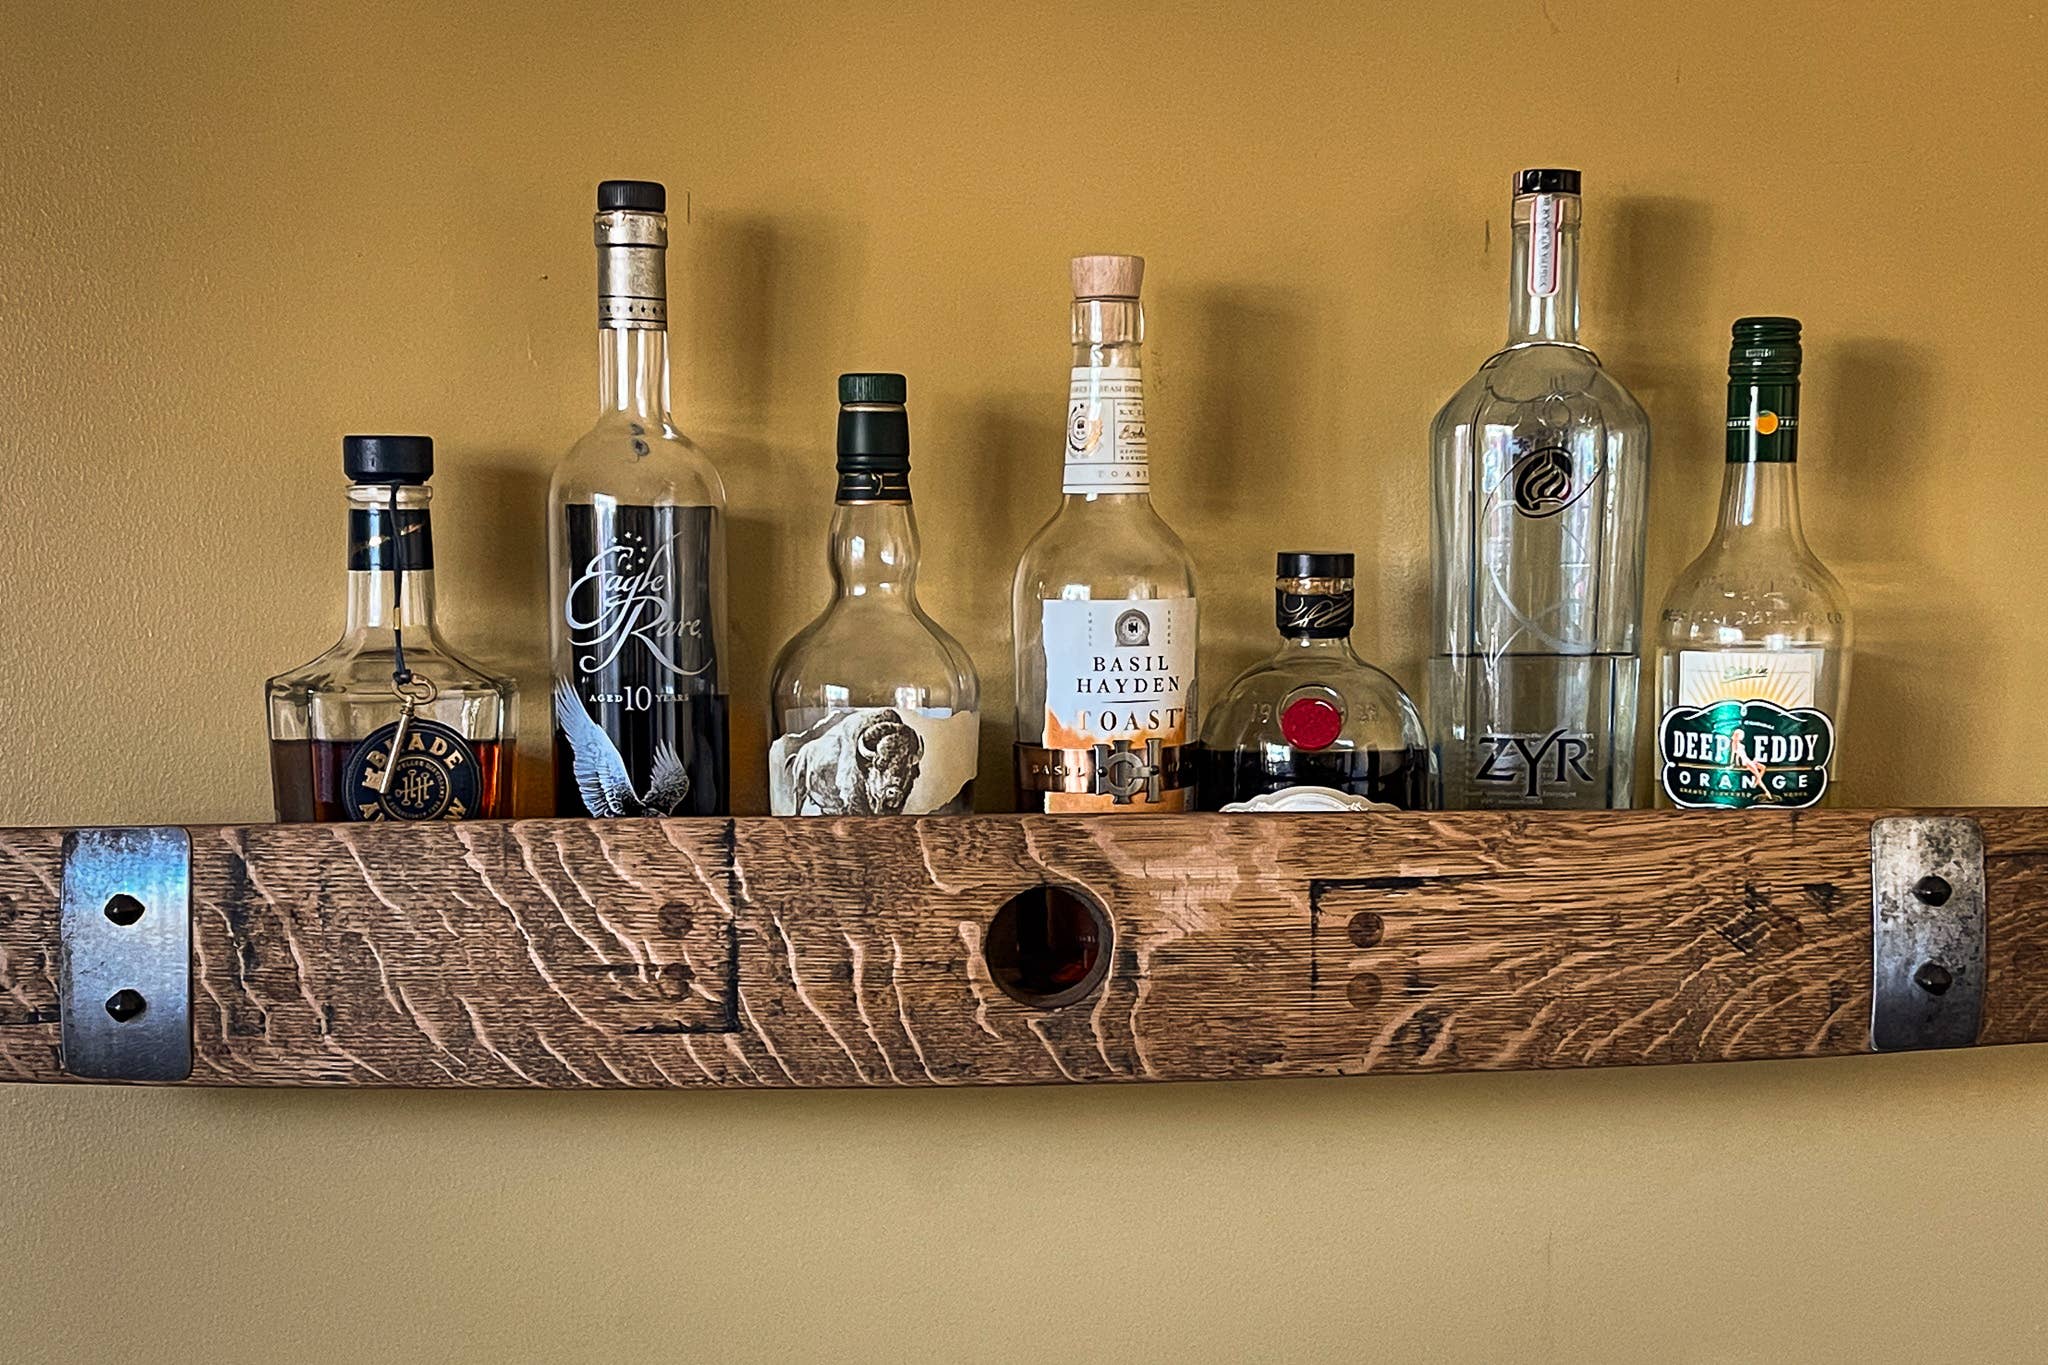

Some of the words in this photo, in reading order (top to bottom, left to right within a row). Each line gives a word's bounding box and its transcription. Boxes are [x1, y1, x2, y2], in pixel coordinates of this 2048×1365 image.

[565, 531, 682, 646] Eagle
[579, 596, 713, 676] Rare
[1094, 655, 1169, 672] BASIL
[1077, 676, 1180, 694] HAYDEN
[590, 693, 623, 703] AGED
[624, 685, 652, 711] 10
[655, 693, 689, 702] YEARS
[1075, 707, 1177, 732] TOAST
[1673, 731, 1732, 765] DEEP
[1753, 734, 1819, 764] EDDY
[1032, 764, 1087, 777] BASIL
[1476, 729, 1594, 797] ZYR
[1679, 771, 1808, 790] ORANGE
